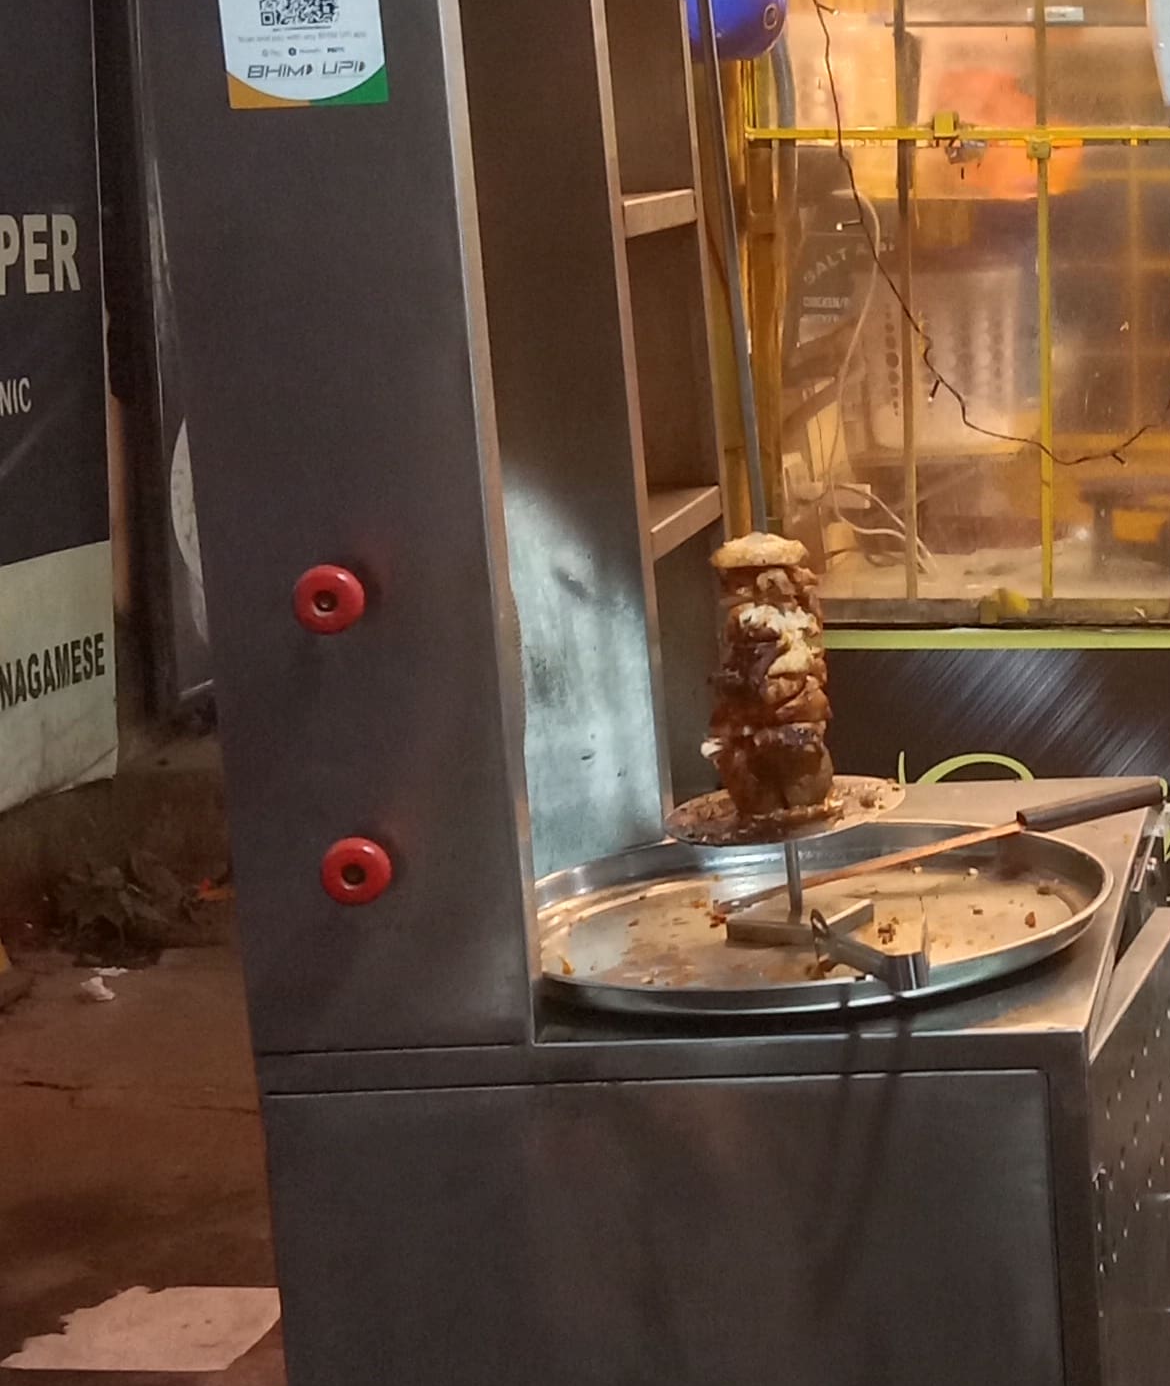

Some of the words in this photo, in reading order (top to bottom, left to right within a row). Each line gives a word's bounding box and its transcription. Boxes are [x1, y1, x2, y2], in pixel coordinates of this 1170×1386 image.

[0, 213, 81, 295] PER
[0, 377, 32, 417] NIC
[0, 632, 105, 712] NAGAMESE
